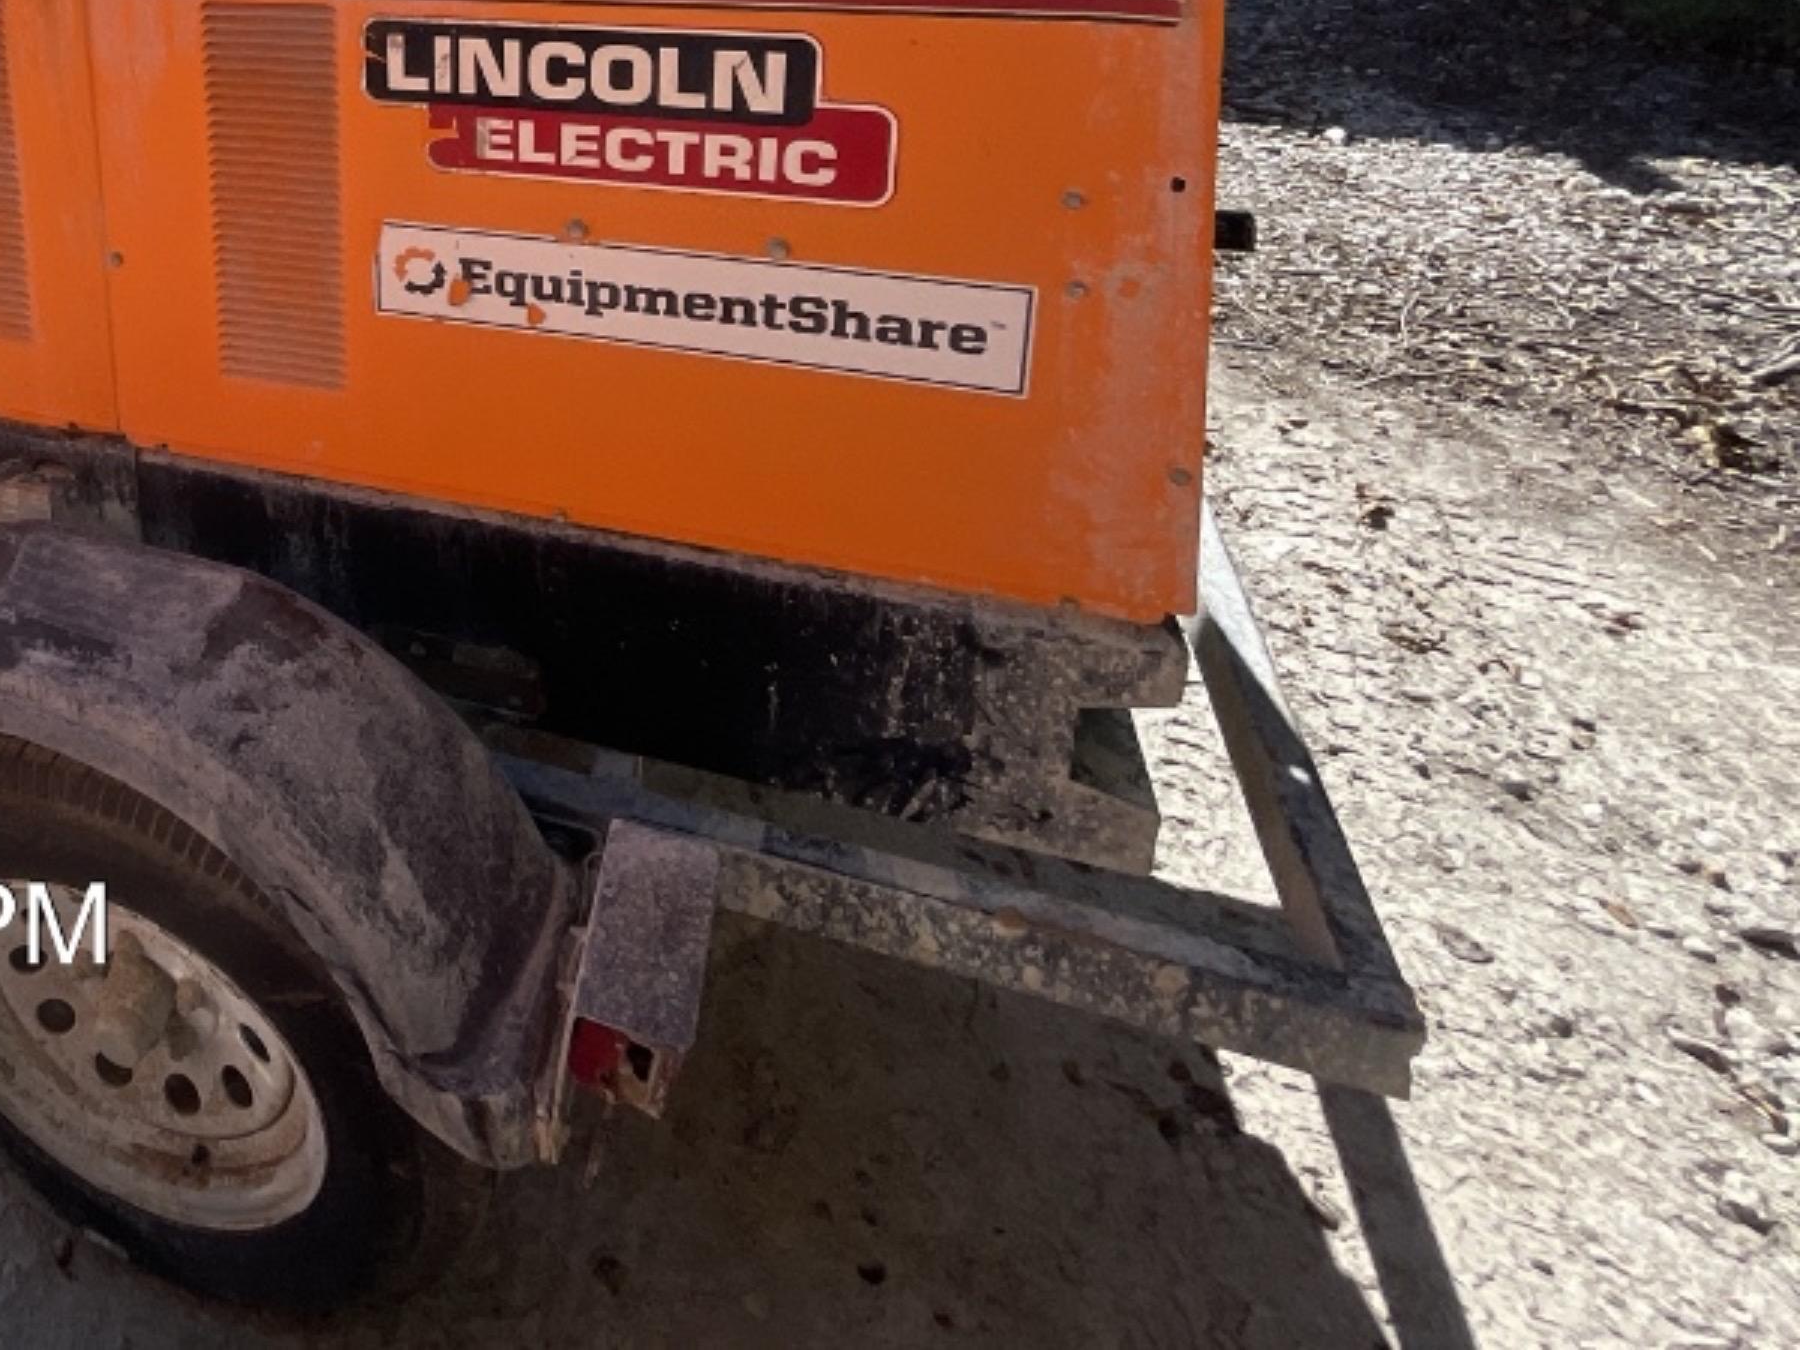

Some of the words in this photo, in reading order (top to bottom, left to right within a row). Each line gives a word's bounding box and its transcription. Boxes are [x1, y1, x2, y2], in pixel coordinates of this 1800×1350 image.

[385, 34, 787, 115] LINCOLN
[476, 117, 838, 187] ELECTRIC
[457, 256, 989, 355] EquipmentShare
